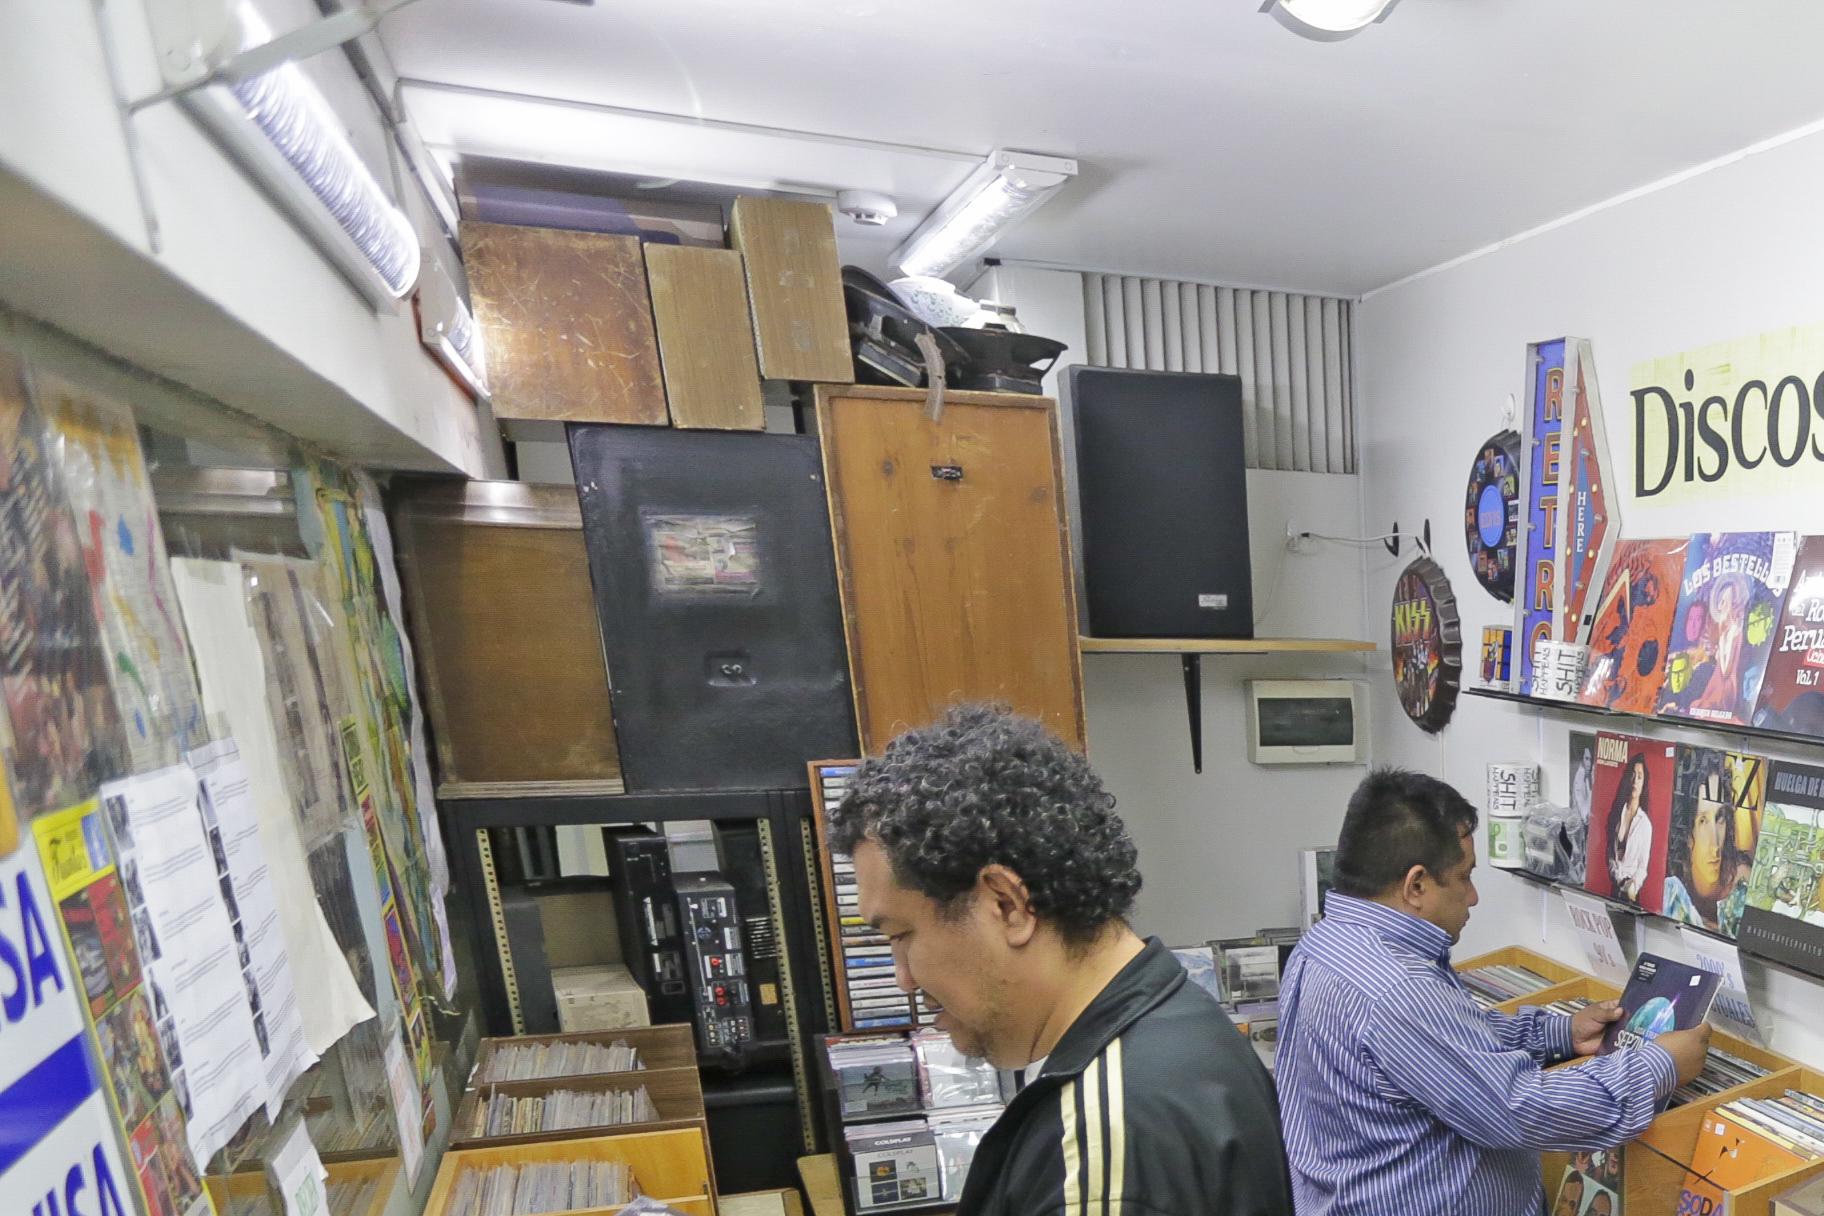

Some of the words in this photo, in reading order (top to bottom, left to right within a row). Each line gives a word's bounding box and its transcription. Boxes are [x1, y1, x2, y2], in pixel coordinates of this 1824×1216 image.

[1576, 491, 1587, 553] HERE
[1684, 564, 1712, 596] LOS
[1394, 599, 1431, 645] KISS
[1556, 650, 1577, 696] SHIT
[1597, 737, 1629, 763] NORMA
[1500, 769, 1516, 810] SHIT
[1774, 771, 1807, 795] HUELGA
[1807, 777, 1820, 797] DE
[874, 1137, 912, 1146] COLDPLAY
